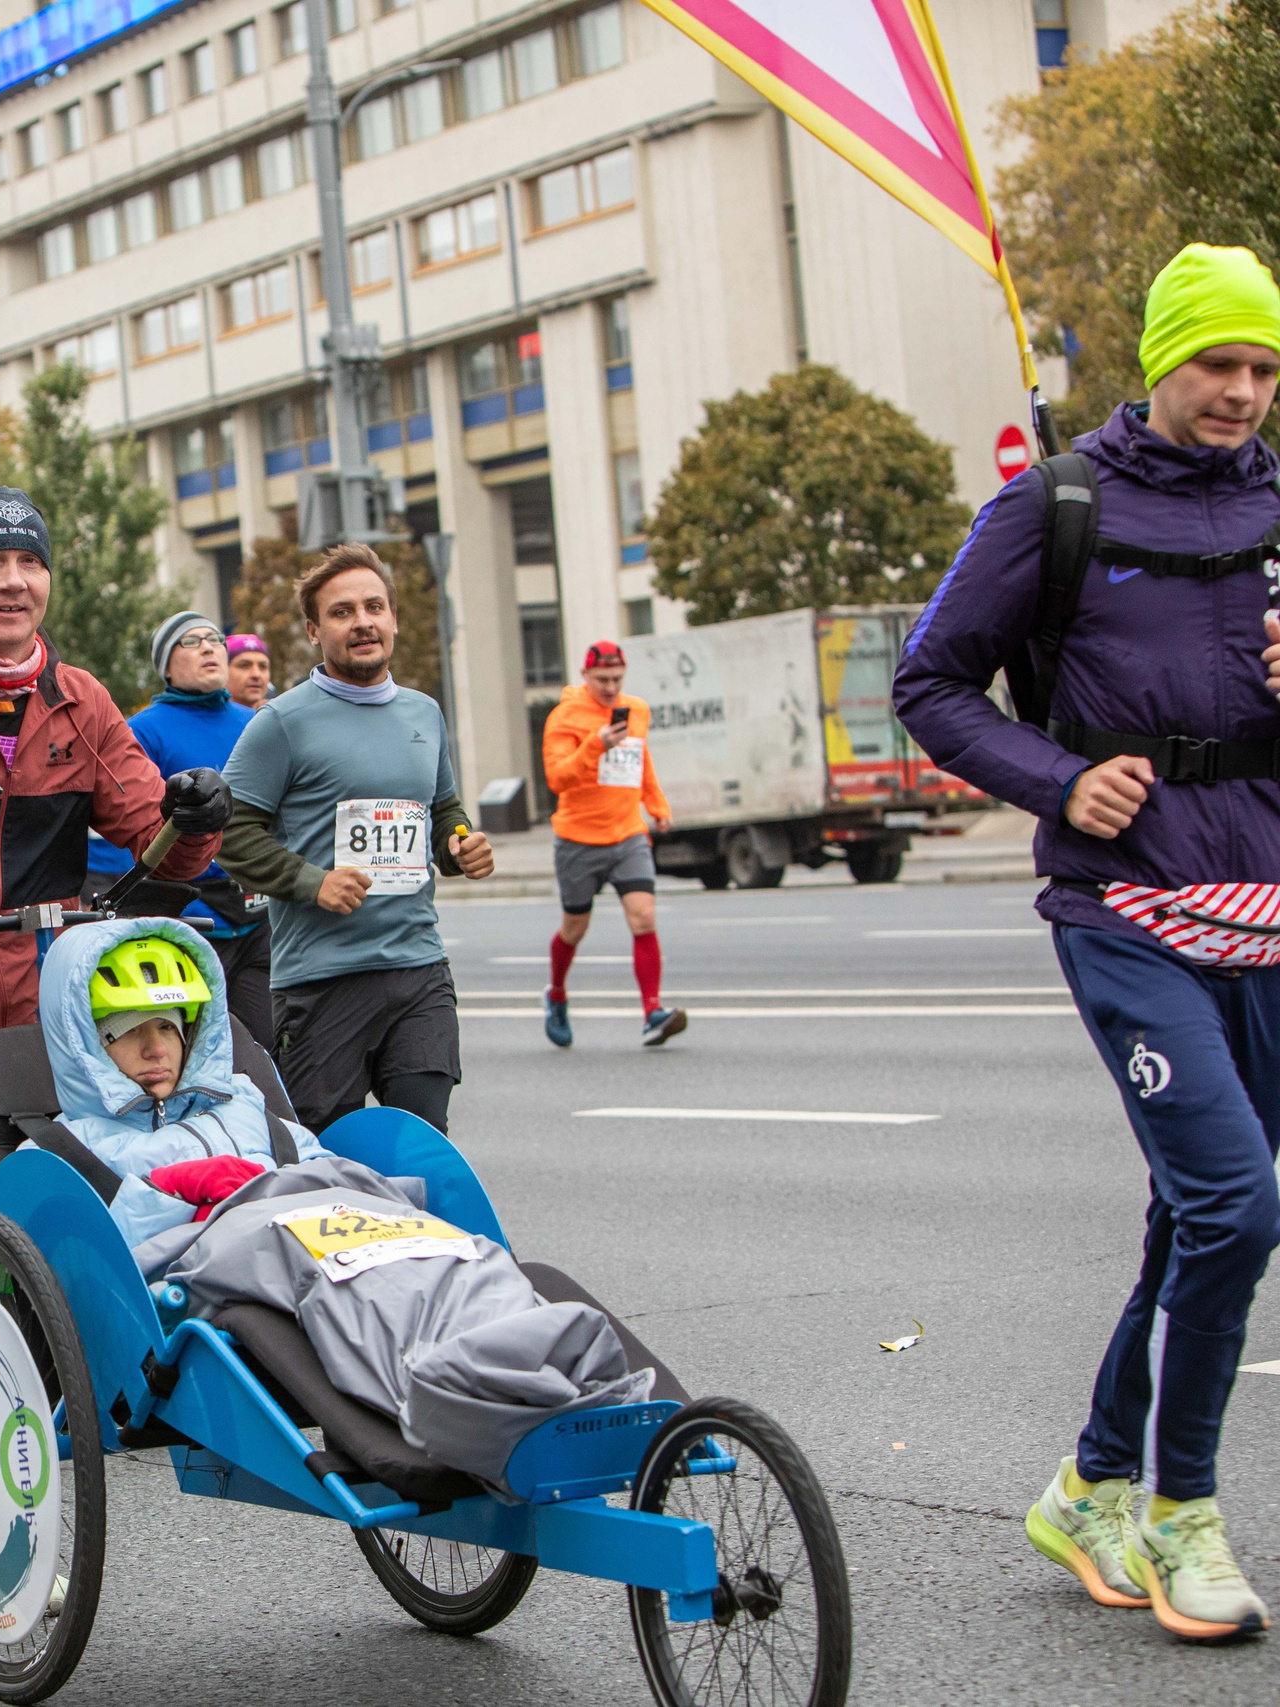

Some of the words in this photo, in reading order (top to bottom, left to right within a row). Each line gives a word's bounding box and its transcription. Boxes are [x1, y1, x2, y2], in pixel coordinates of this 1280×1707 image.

[349, 824, 417, 853] 8117
[371, 856, 400, 865] ДЕНИС
[14, 1397, 37, 1527] АРНИГЕЛЬ
